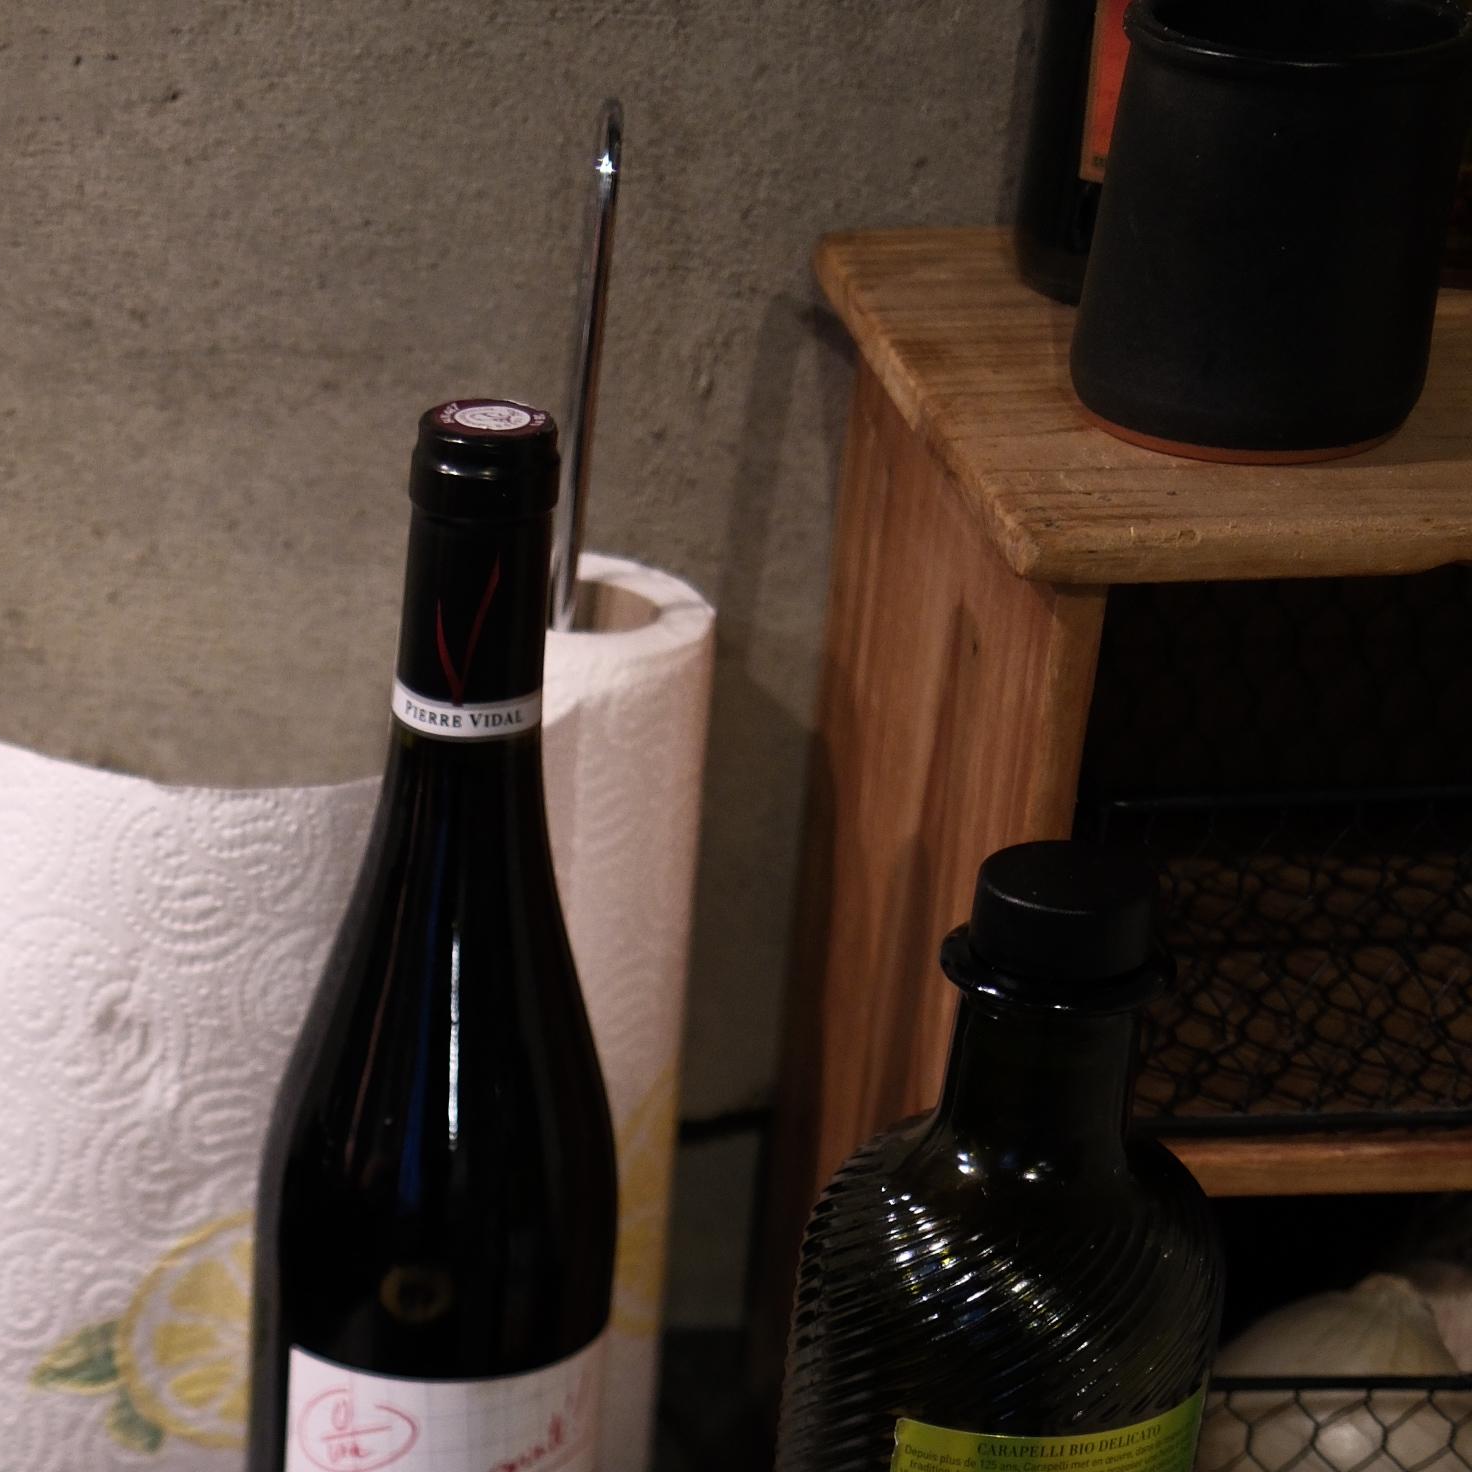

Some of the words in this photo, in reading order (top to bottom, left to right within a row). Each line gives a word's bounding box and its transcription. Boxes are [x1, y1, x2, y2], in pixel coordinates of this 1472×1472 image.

[404, 700, 463, 728] PIERRE
[469, 709, 524, 727] VIDAL
[976, 1442, 1065, 1458] CARAPELLI
[1068, 1442, 1096, 1457] BIO
[1098, 1424, 1161, 1452] DELICATO
[904, 1444, 939, 1461] Depuis
[939, 1454, 962, 1466] plus
[964, 1457, 977, 1468] de
[979, 1460, 997, 1470] 125
[1023, 1461, 1069, 1472] Carapelli
[1071, 1459, 1090, 1469] met
